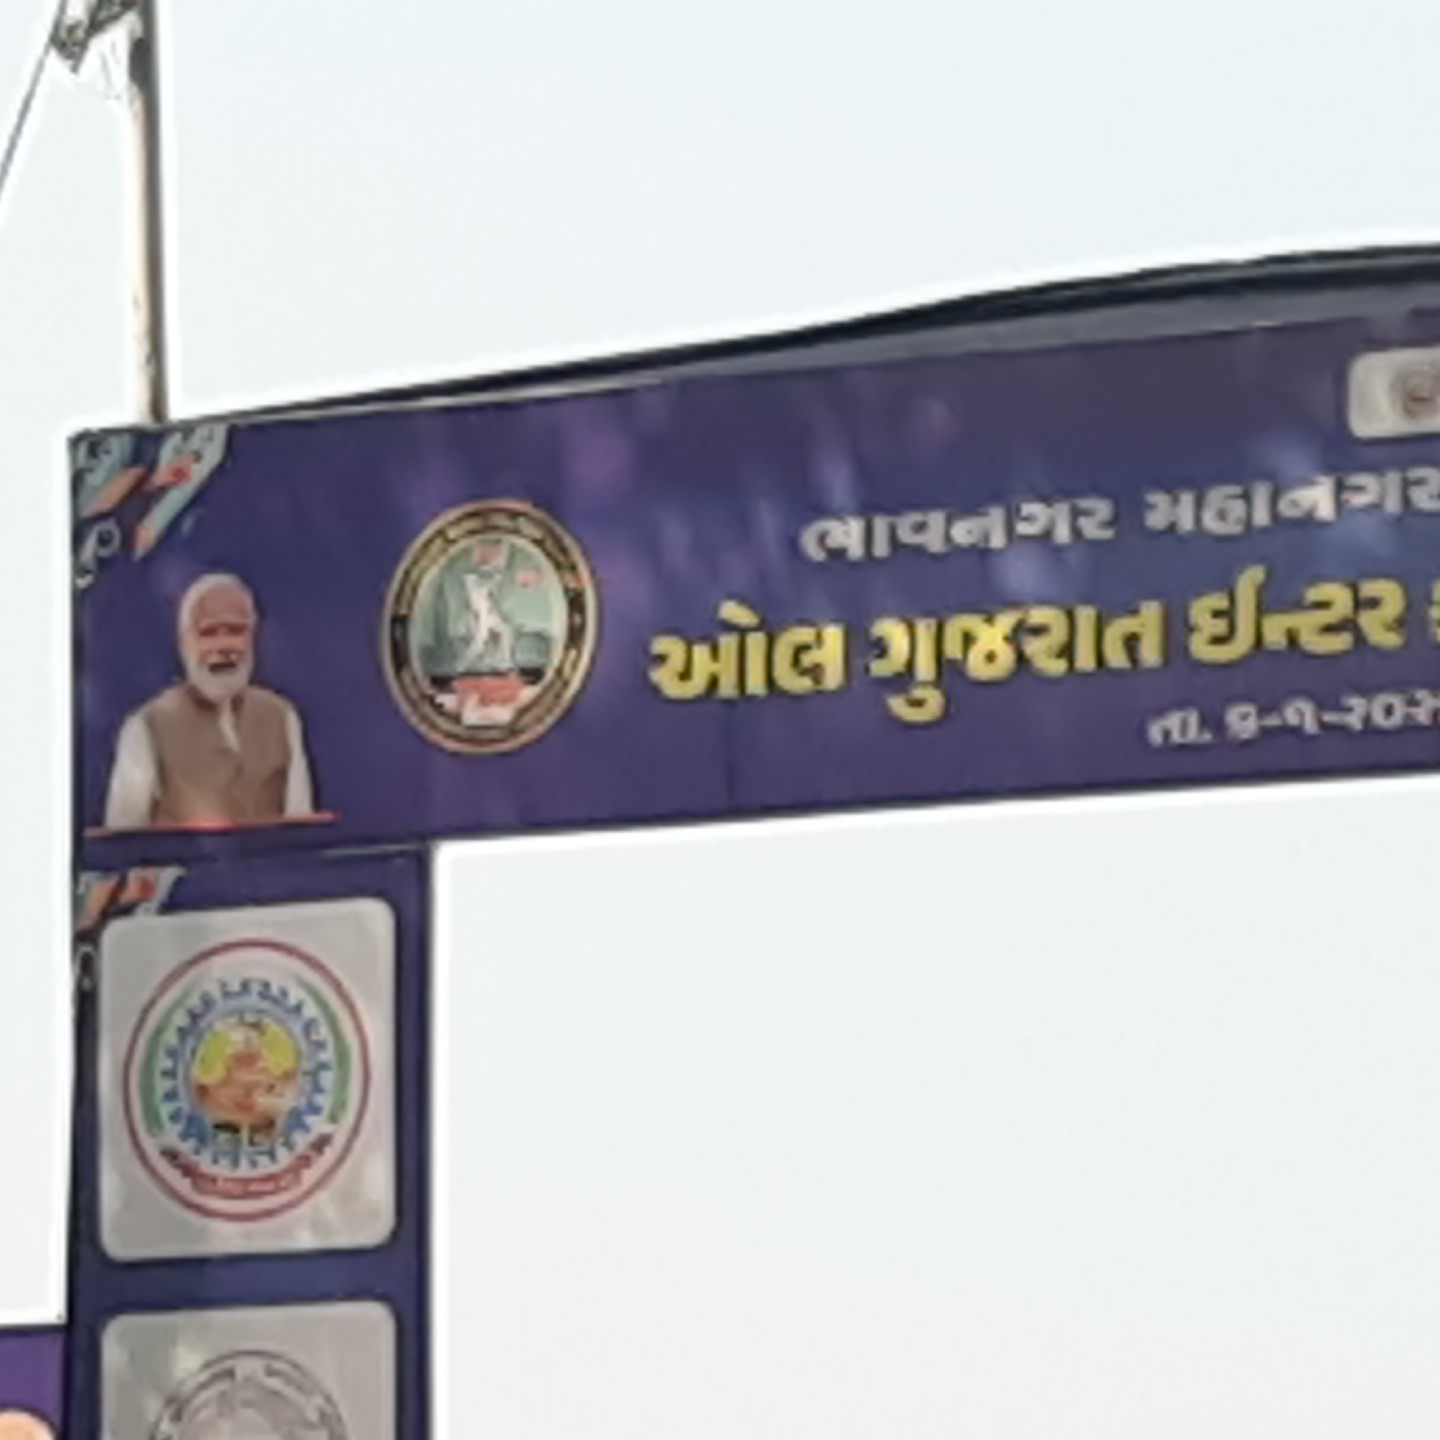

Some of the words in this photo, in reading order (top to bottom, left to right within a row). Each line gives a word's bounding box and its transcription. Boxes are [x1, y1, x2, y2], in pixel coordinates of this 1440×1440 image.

[800, 503, 1113, 562] ભાવનગર
[649, 601, 844, 698] ઓલ
[869, 602, 1160, 721] ગુજરાત
[1189, 565, 1405, 662] ઈન્ટર
